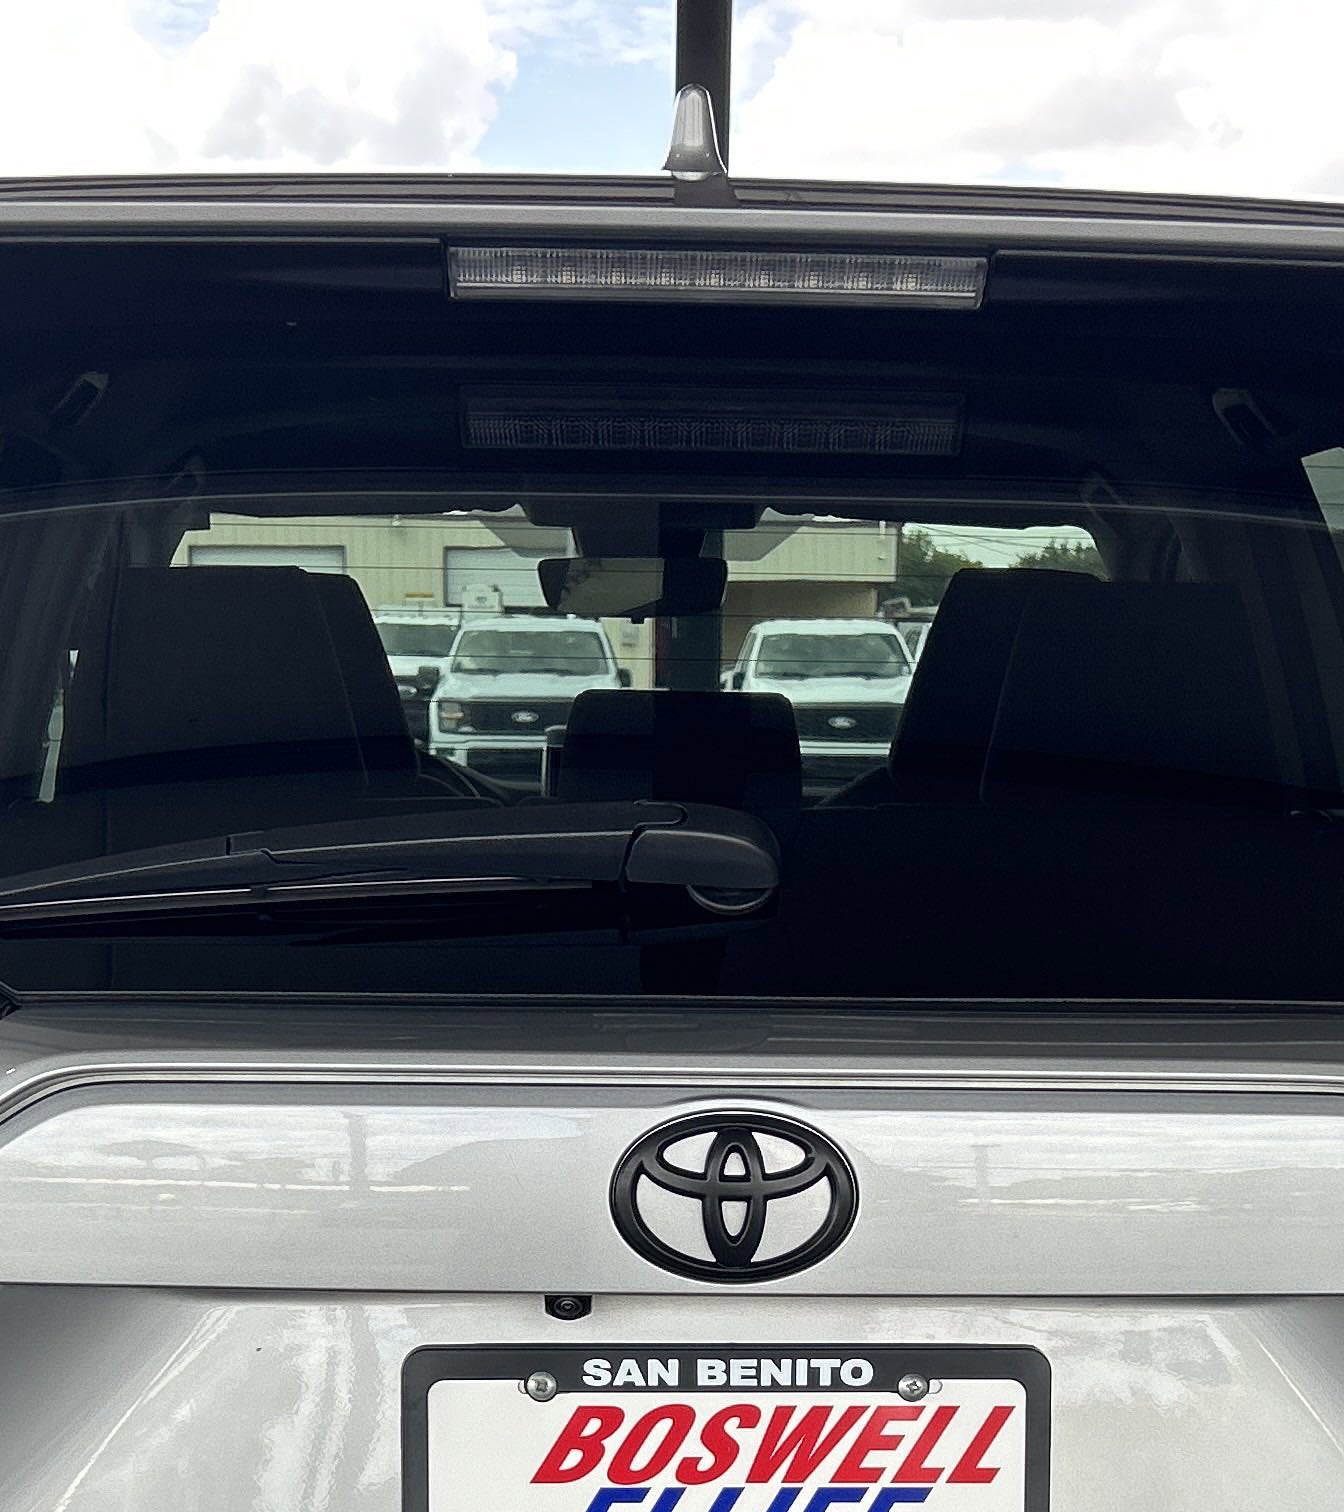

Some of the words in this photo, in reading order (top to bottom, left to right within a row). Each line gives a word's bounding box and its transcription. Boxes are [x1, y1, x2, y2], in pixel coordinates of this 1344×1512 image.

[582, 1358, 679, 1387] SAN
[696, 1358, 874, 1387] BENITO
[530, 1404, 1017, 1484] BOSWELL
